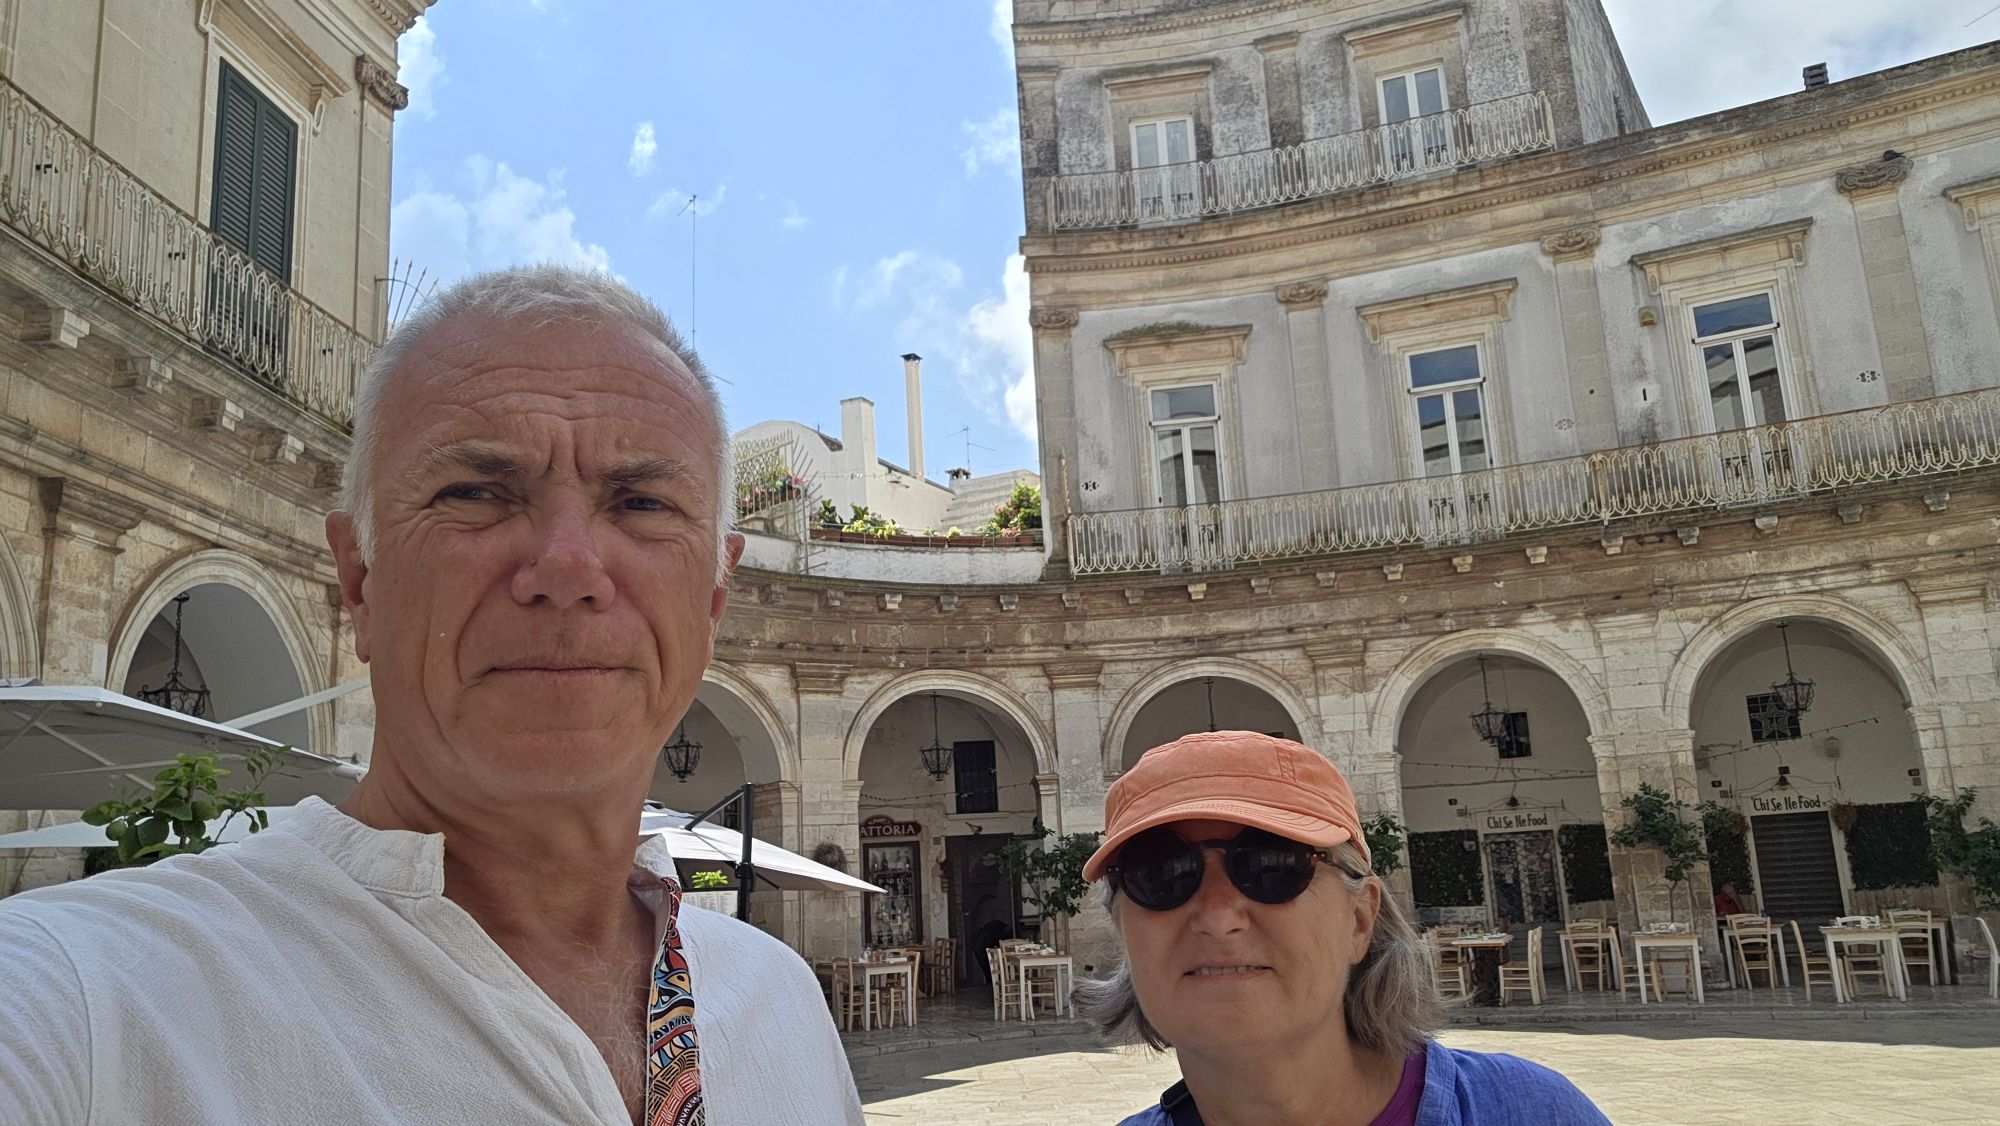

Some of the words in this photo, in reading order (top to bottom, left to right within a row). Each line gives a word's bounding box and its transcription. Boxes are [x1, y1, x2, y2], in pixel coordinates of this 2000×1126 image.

[1753, 797, 1770, 811] Chi
[1771, 798, 1783, 811] Se
[1798, 795, 1821, 809] Food
[1487, 815, 1502, 829] Chi
[1503, 816, 1513, 829] Se
[1527, 813, 1548, 826] Food
